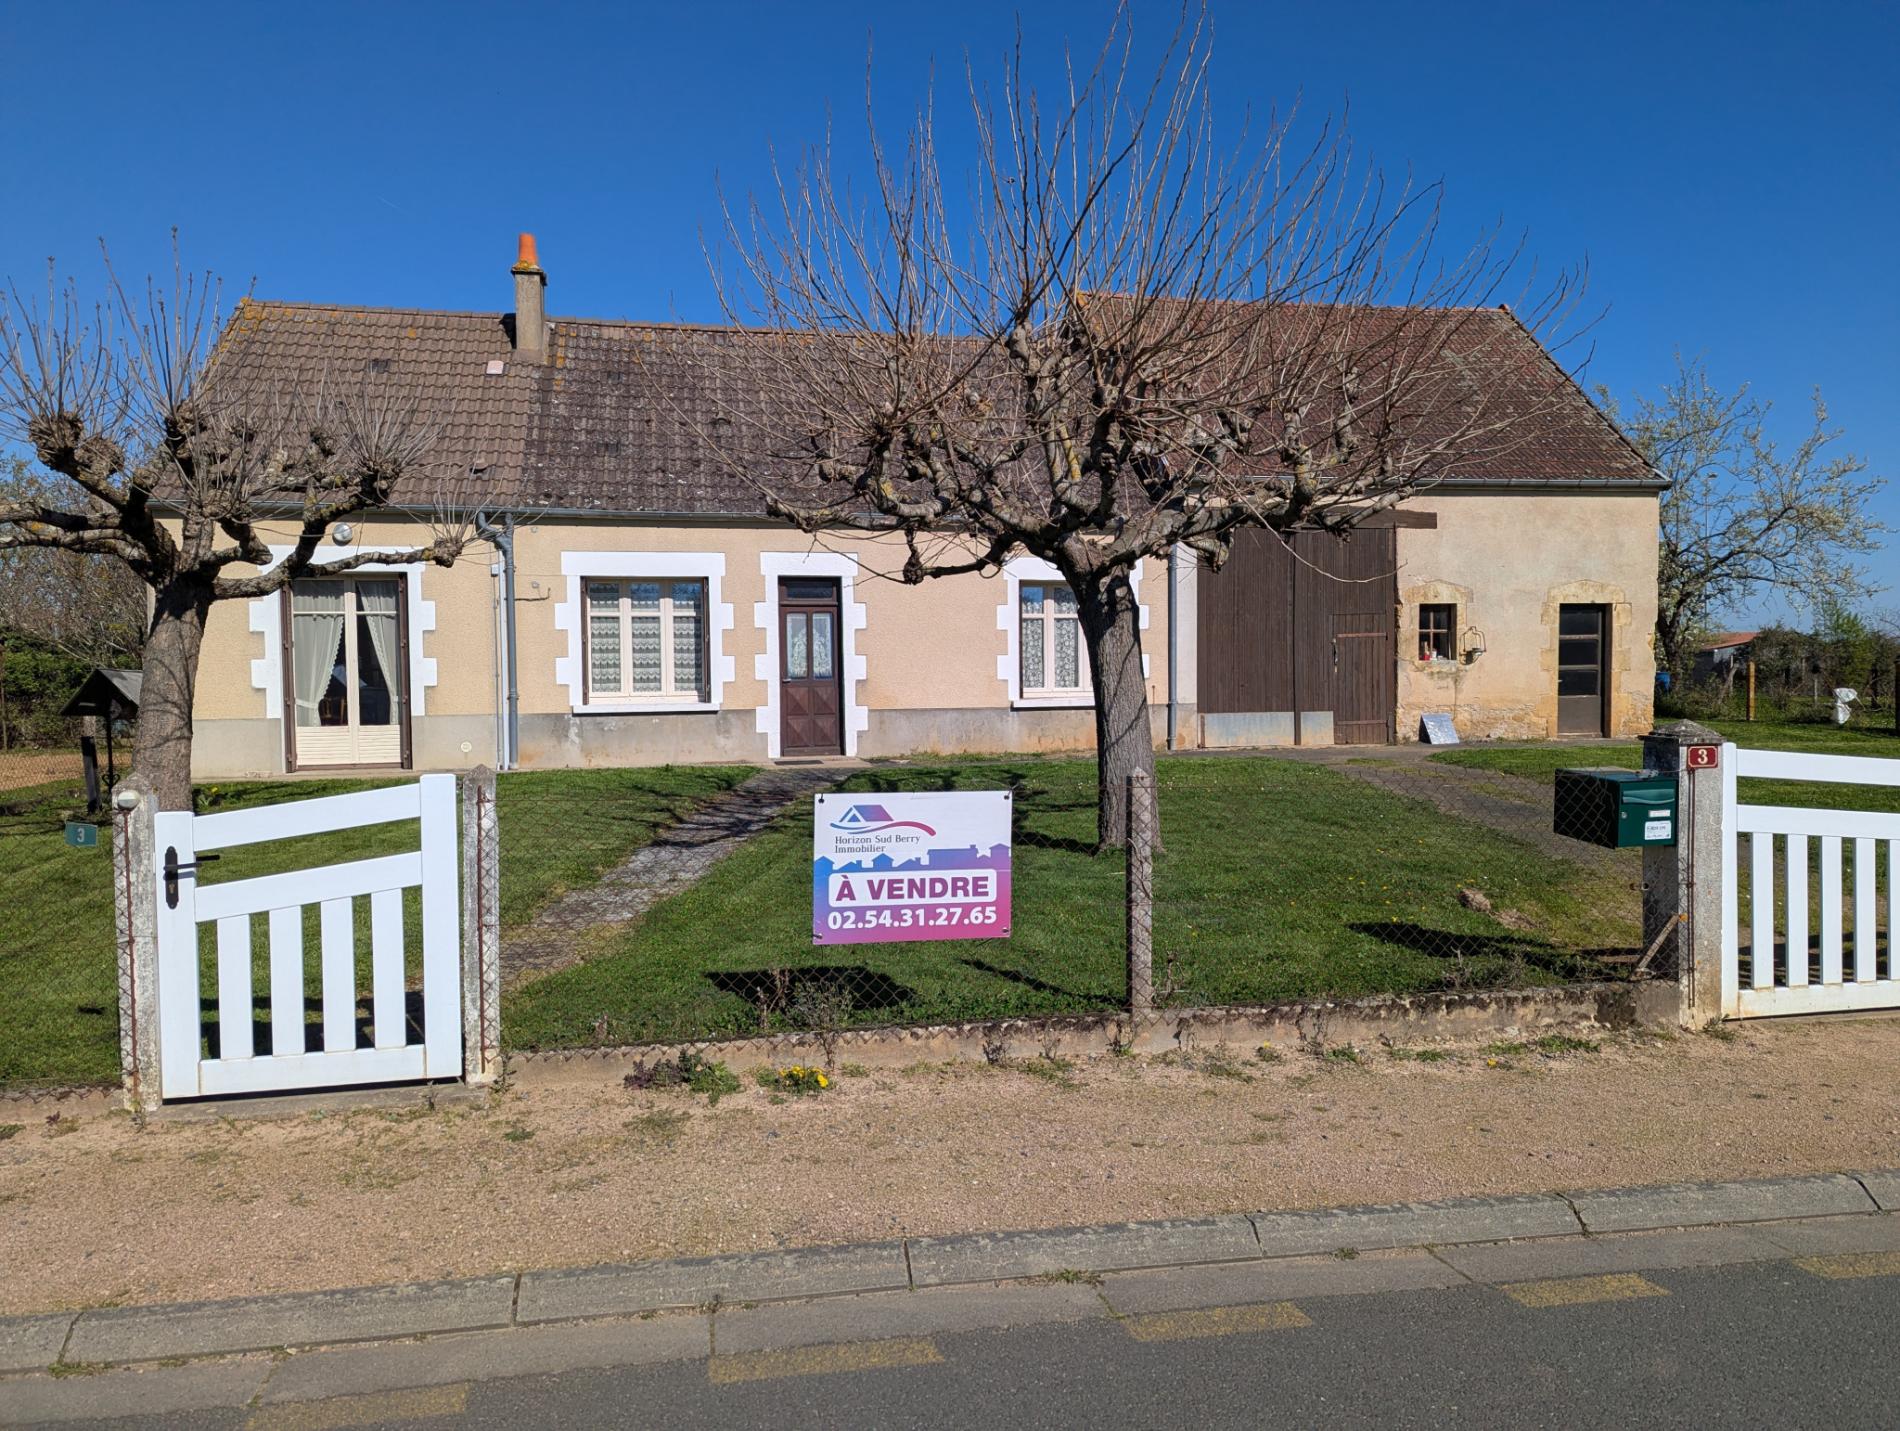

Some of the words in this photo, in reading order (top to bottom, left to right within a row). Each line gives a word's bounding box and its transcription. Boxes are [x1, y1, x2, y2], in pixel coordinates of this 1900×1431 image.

[1697, 748, 1708, 765] 3
[77, 828, 85, 842] 3
[835, 836, 872, 845] Horizon
[875, 835, 892, 843] Sud
[895, 834, 920, 844] Berry
[835, 845, 886, 853] Immobilier
[836, 875, 856, 901] À
[867, 876, 989, 900] VENDRE
[827, 907, 997, 930] 02.54.31.27.65
